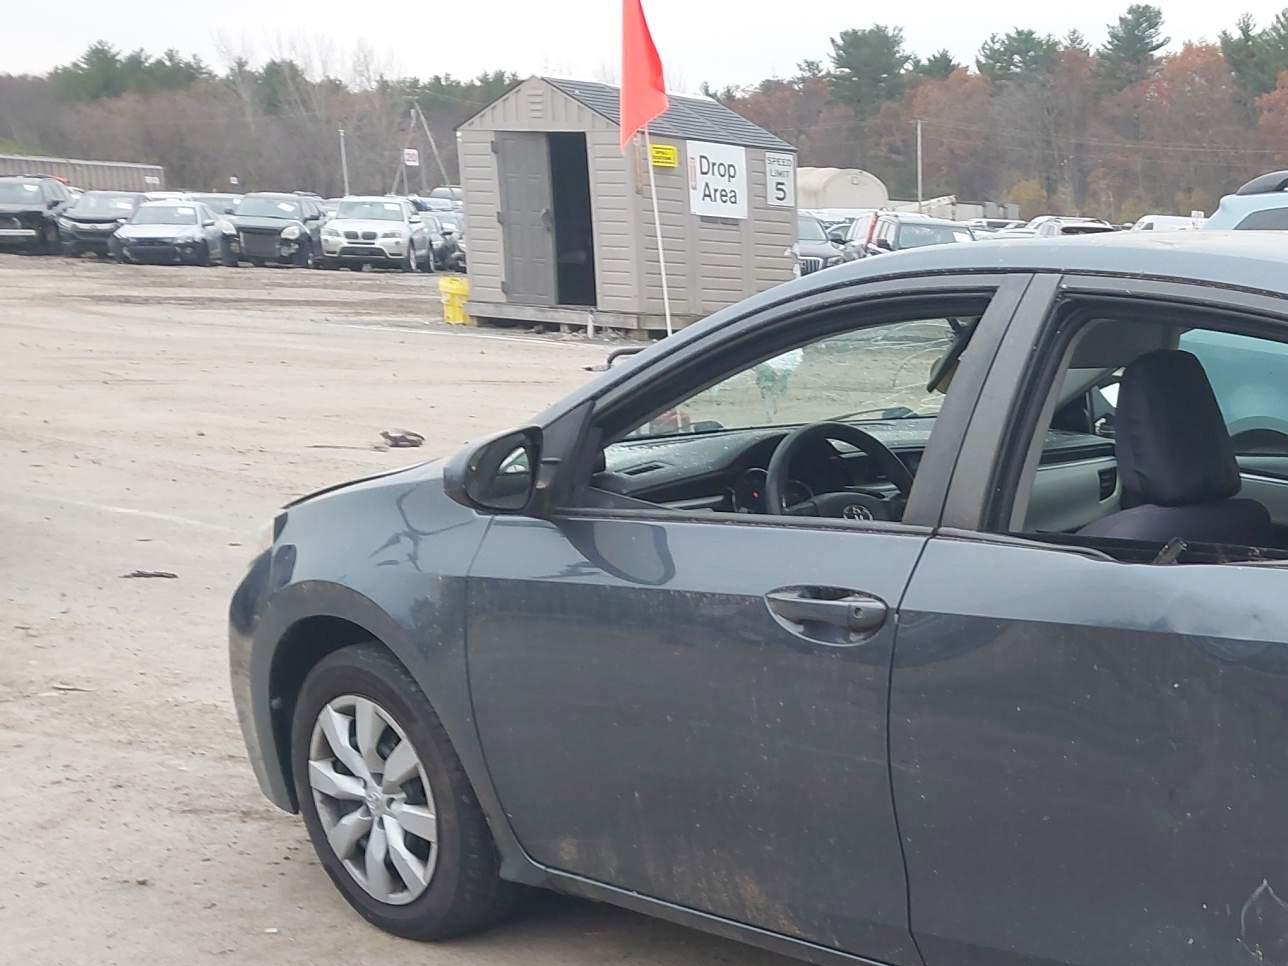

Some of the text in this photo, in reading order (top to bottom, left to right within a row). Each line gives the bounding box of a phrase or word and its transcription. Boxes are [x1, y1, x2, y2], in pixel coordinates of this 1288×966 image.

[699, 155, 737, 183] Drop
[767, 157, 793, 167] SPEED
[769, 169, 791, 178] LIMIT
[702, 182, 738, 204] Area
[775, 182, 787, 201] 5
